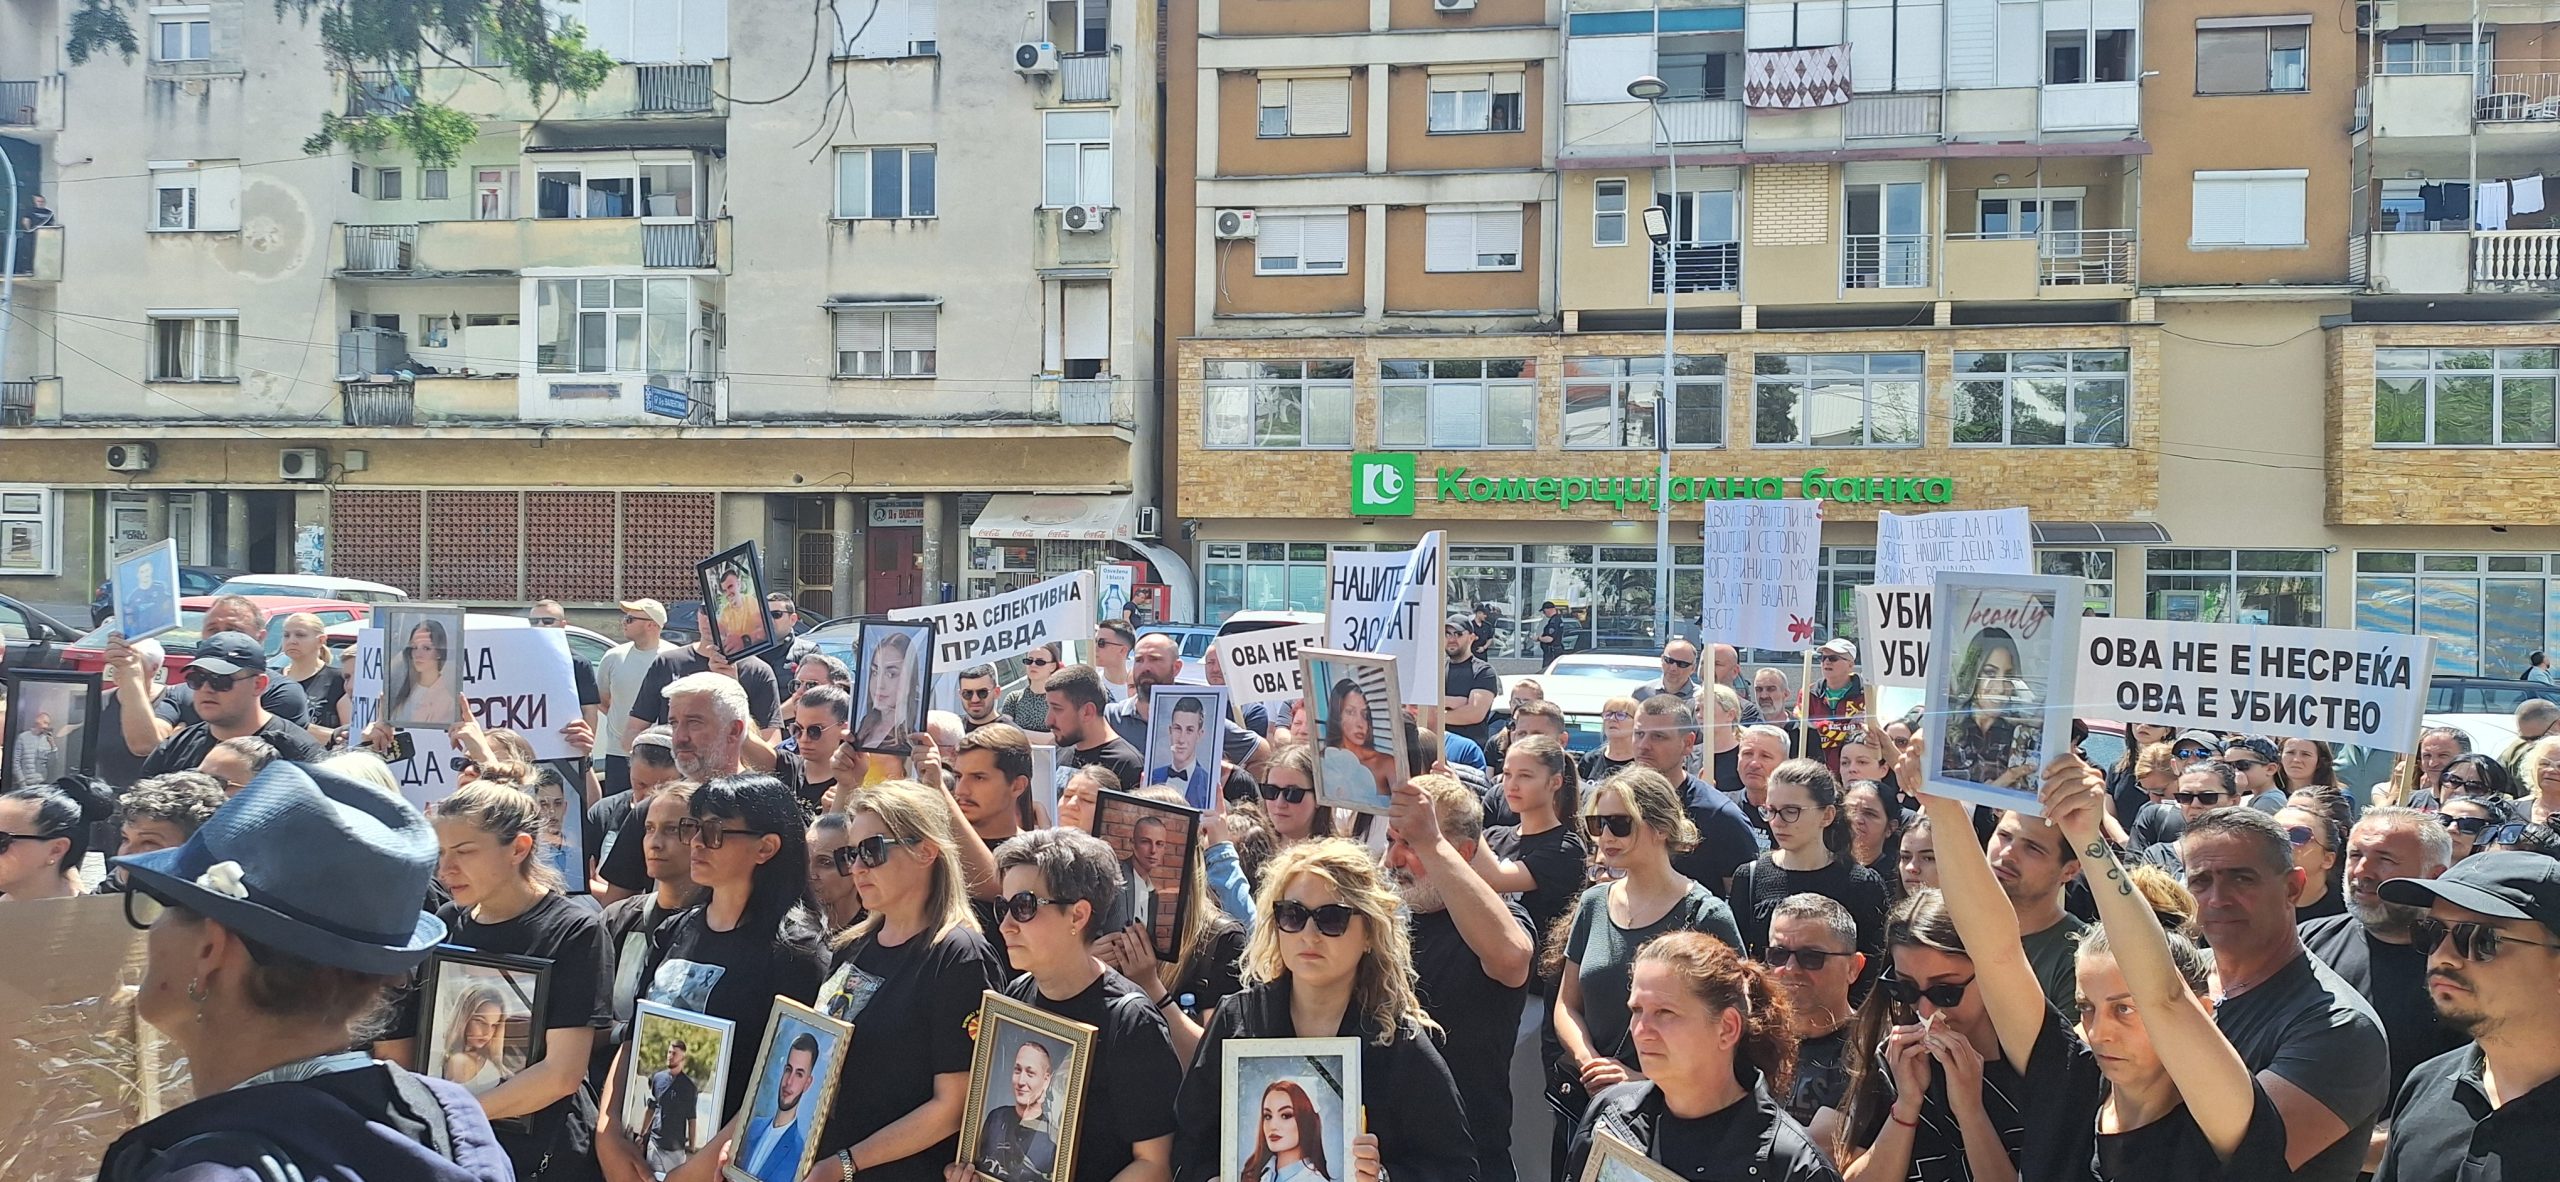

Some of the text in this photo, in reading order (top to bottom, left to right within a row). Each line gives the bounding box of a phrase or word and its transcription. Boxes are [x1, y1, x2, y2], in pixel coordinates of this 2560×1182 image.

[1437, 466, 1953, 512] Комерцијална банка
[1908, 517, 1957, 540] ТРЕБАШЕ
[1962, 515, 1981, 538] ДА
[1987, 515, 2004, 536] ГИ
[1915, 541, 1954, 563] НАШИТЕ
[1959, 540, 1994, 562] ДЕЦА
[953, 611, 978, 633] ЗА
[982, 581, 1081, 628] СЕЛЕКТИВНА
[941, 619, 1047, 663] ПРАВДА
[1231, 644, 1270, 667] ОВА
[1272, 639, 1299, 662] НЕ
[2090, 636, 2411, 690] ОВА НЕ Е НЕСРЕЌА
[1253, 670, 1288, 693] ОВА
[2116, 681, 2381, 735] ОВА Е УБИСТВО
